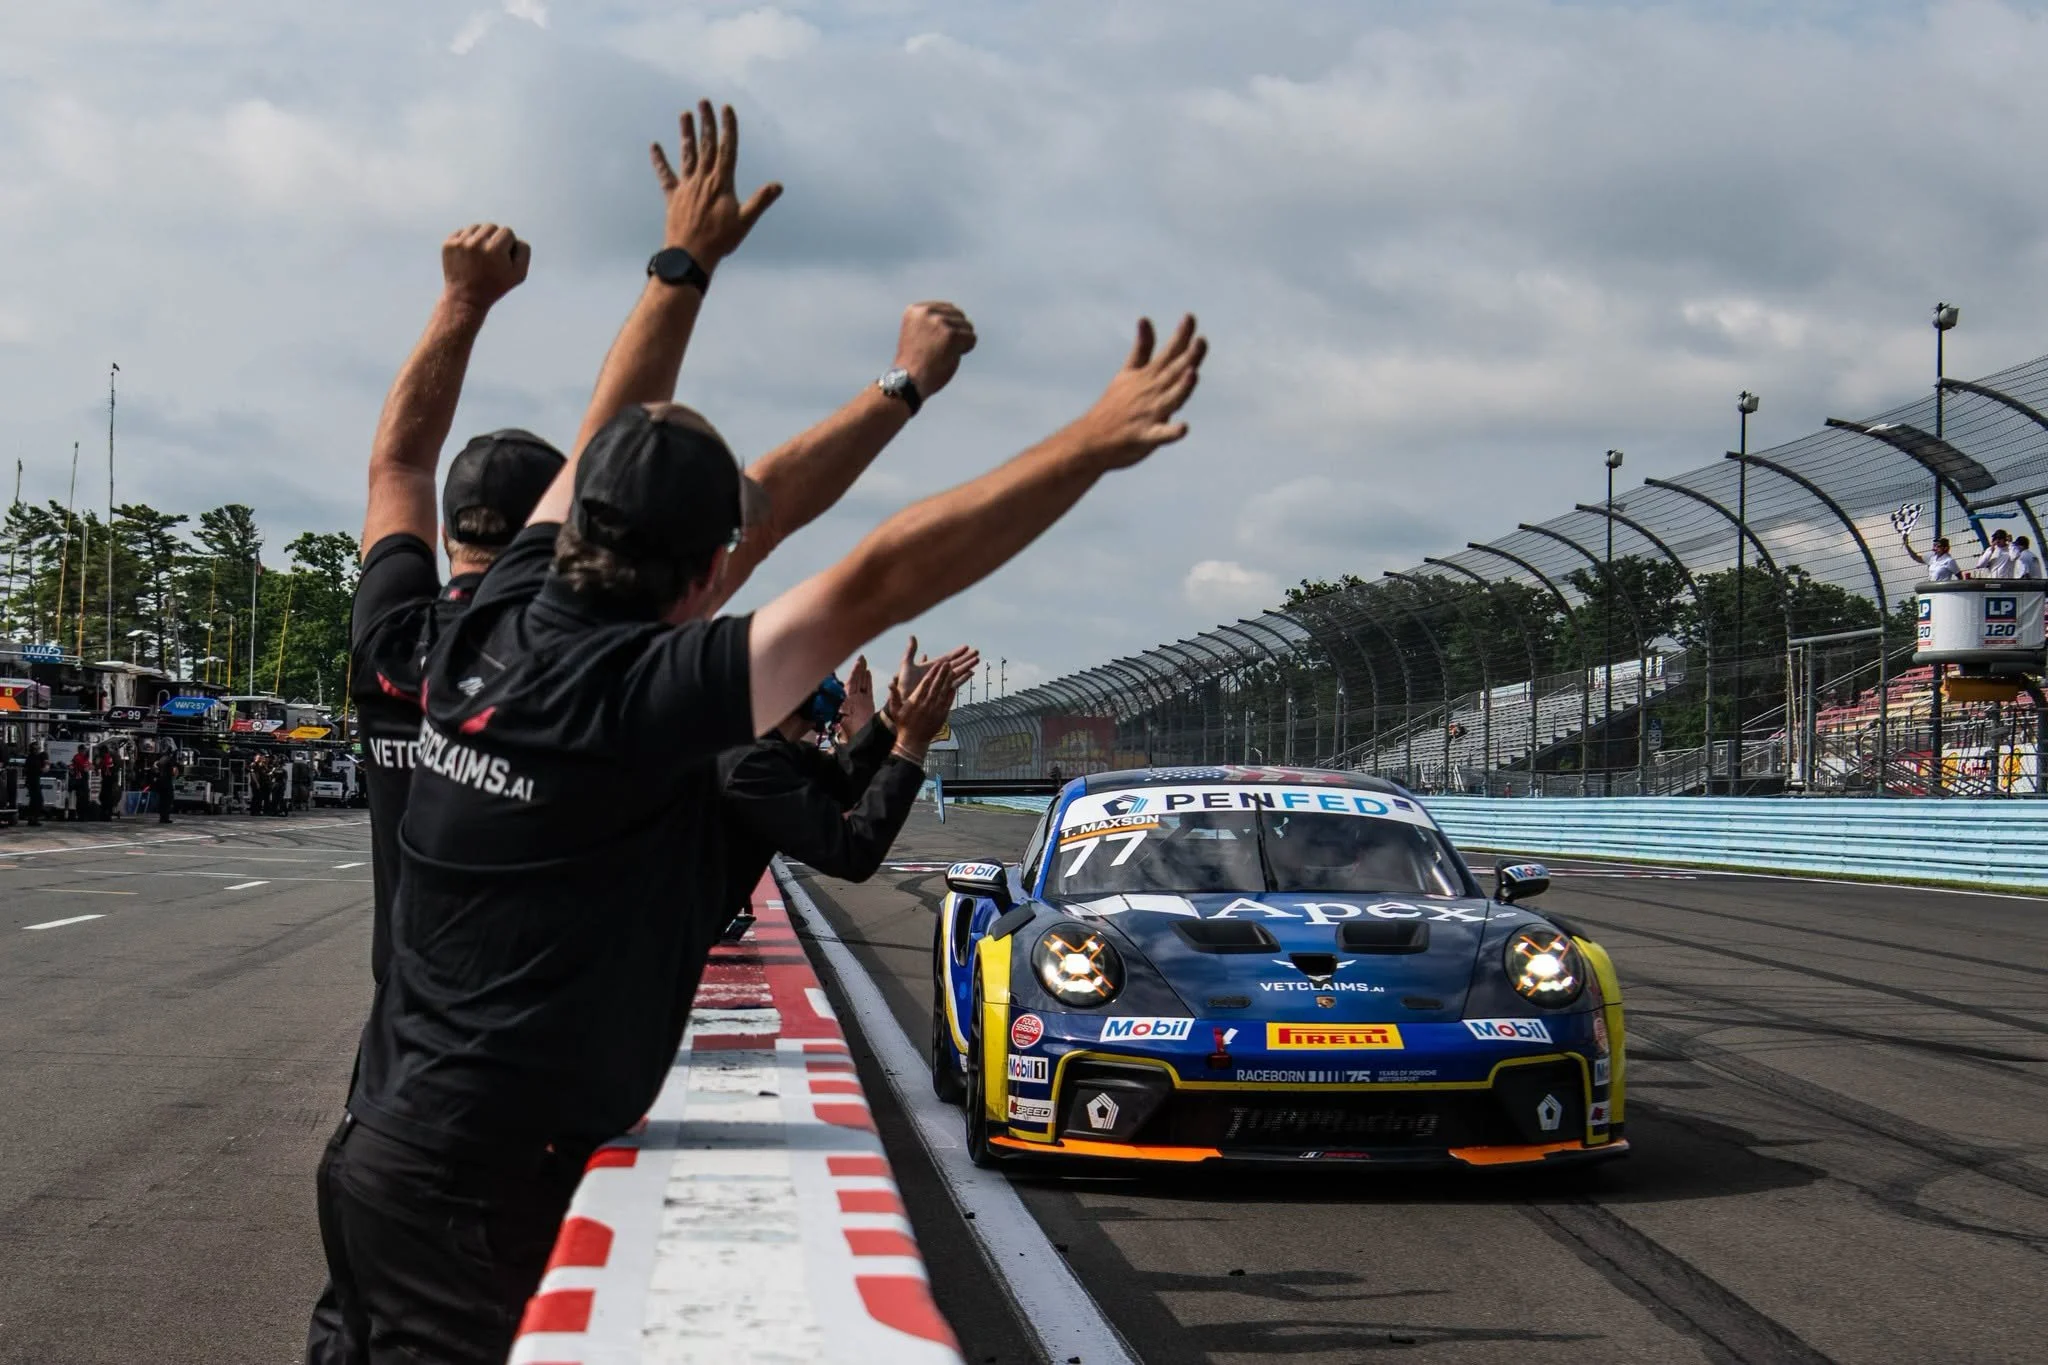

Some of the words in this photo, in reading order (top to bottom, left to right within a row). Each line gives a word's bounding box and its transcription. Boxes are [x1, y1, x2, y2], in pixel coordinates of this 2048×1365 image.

[1989, 601, 2013, 616] LP
[1919, 626, 1931, 638] 20
[1985, 624, 2016, 637] 120
[127, 710, 141, 720] 99
[1165, 792, 1390, 815] PENFED
[1060, 828, 1076, 839] T.
[1080, 814, 1160, 834] MAXSON
[1060, 830, 1148, 879] 77
[950, 864, 998, 877] Mobil
[1207, 897, 1494, 925] Apex
[1259, 982, 1385, 993] VETCLAIMS.AI
[1106, 1020, 1188, 1037] Mobil
[1278, 1027, 1389, 1045] PIRELLI
[1469, 1021, 1548, 1040] Mobil
[1009, 1057, 1033, 1079] Mobil
[1236, 1069, 1306, 1082] RACEBORN
[1345, 1070, 1371, 1083] 75
